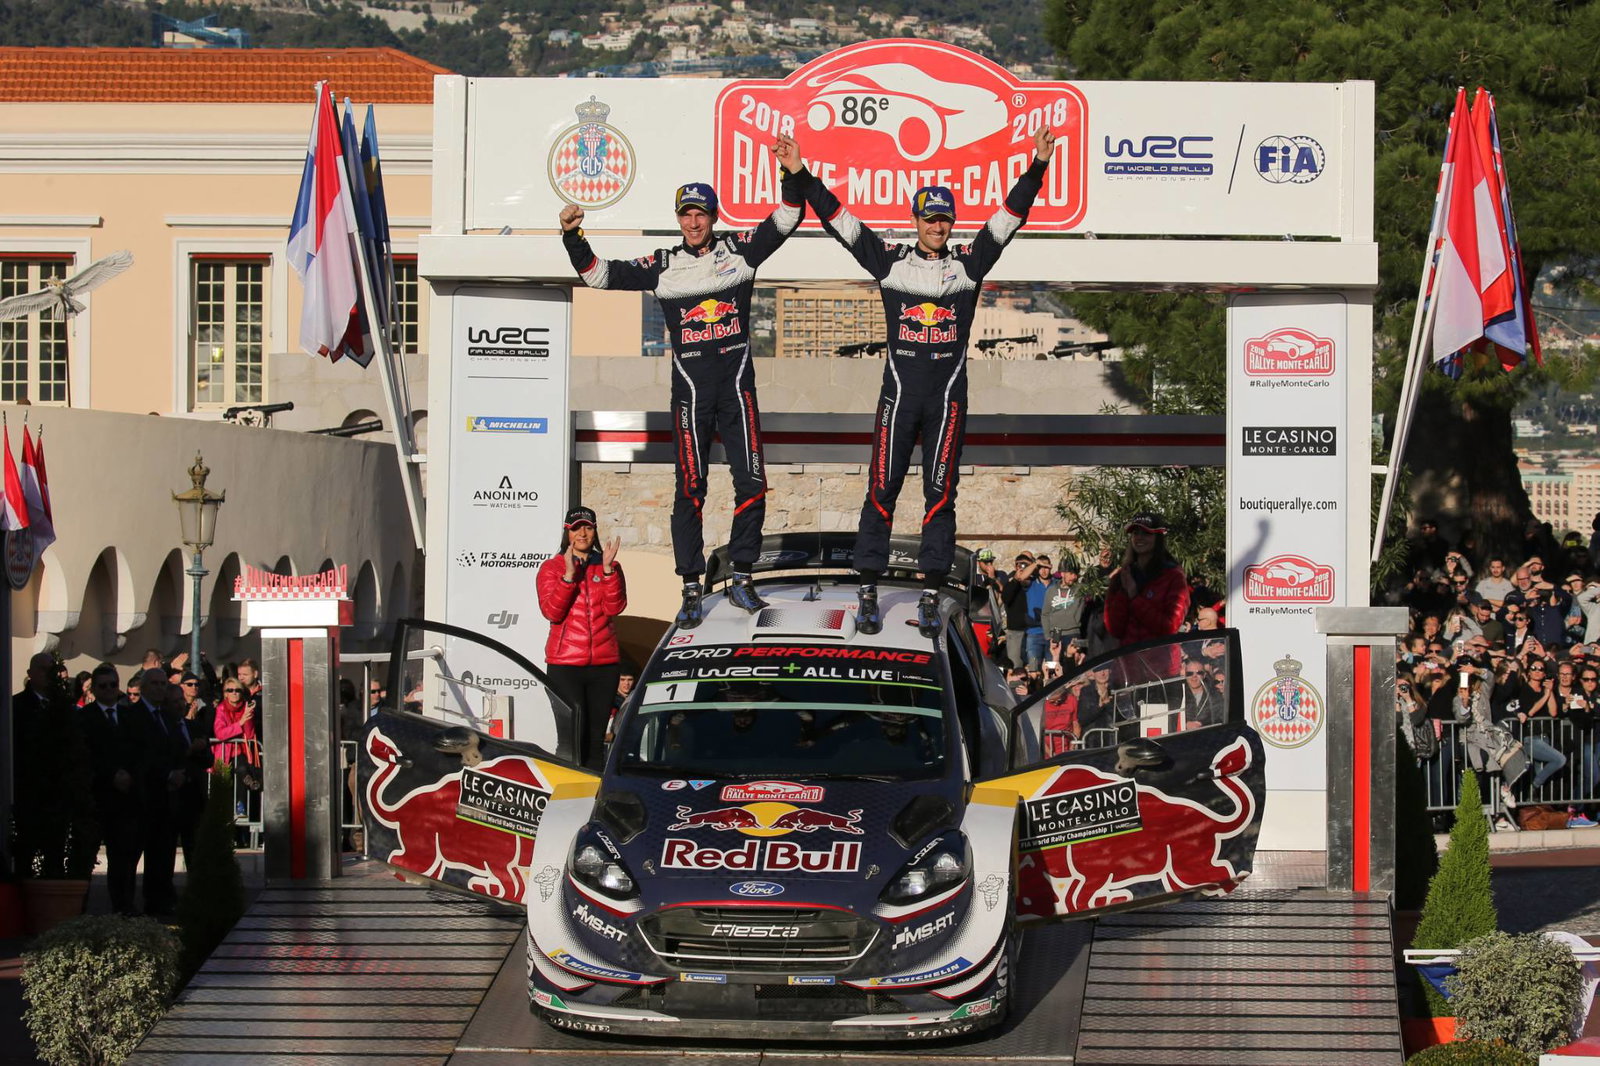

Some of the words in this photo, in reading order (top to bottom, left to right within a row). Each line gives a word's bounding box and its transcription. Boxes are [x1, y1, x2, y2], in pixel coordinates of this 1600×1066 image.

[739, 94, 796, 139] 2018
[1011, 98, 1067, 144] 2018
[1104, 135, 1214, 159] WRC
[468, 326, 550, 345] WRC
[681, 323, 713, 344] Red
[713, 317, 741, 339] Bull
[898, 323, 929, 343] Red
[930, 324, 957, 343] Bull
[1249, 352, 1275, 370] RALLYE
[1249, 379, 1330, 389] #RallyeMonteCarlo
[681, 406, 689, 429] FORD
[881, 403, 891, 426] FORD
[488, 421, 541, 430] MICHELIN
[1245, 430, 1262, 443] LE
[1265, 430, 1334, 443] CASINO
[752, 452, 760, 476] FORD
[935, 463, 946, 486] FORD
[473, 490, 539, 501] ANONIMO
[1239, 497, 1338, 514] boutiquerallye.com
[480, 560, 541, 569] MOTORSPORT
[500, 552, 517, 560] ALL
[519, 552, 553, 560] ABOUT
[1248, 578, 1275, 597] RALLYE
[1249, 606, 1314, 616] #RallyeMonteC
[663, 647, 733, 662] FORD
[732, 647, 934, 665] PERFORMANCE
[475, 675, 538, 690] tamaggo
[803, 666, 842, 678] ALL
[848, 667, 893, 681] LIVE
[666, 683, 678, 700] 1
[464, 773, 481, 793] LE
[482, 780, 548, 812] CASINO
[725, 791, 755, 799] RALLYE
[1031, 802, 1052, 821] LE
[1056, 787, 1133, 816] CASINO
[1050, 835, 1066, 844] Rally
[1066, 827, 1108, 840] Championship
[661, 838, 761, 871] Red
[763, 840, 863, 873] Bull
[738, 882, 777, 895] Ford
[568, 961, 631, 978] MICHELIN
[897, 963, 960, 983] MICHELIN
